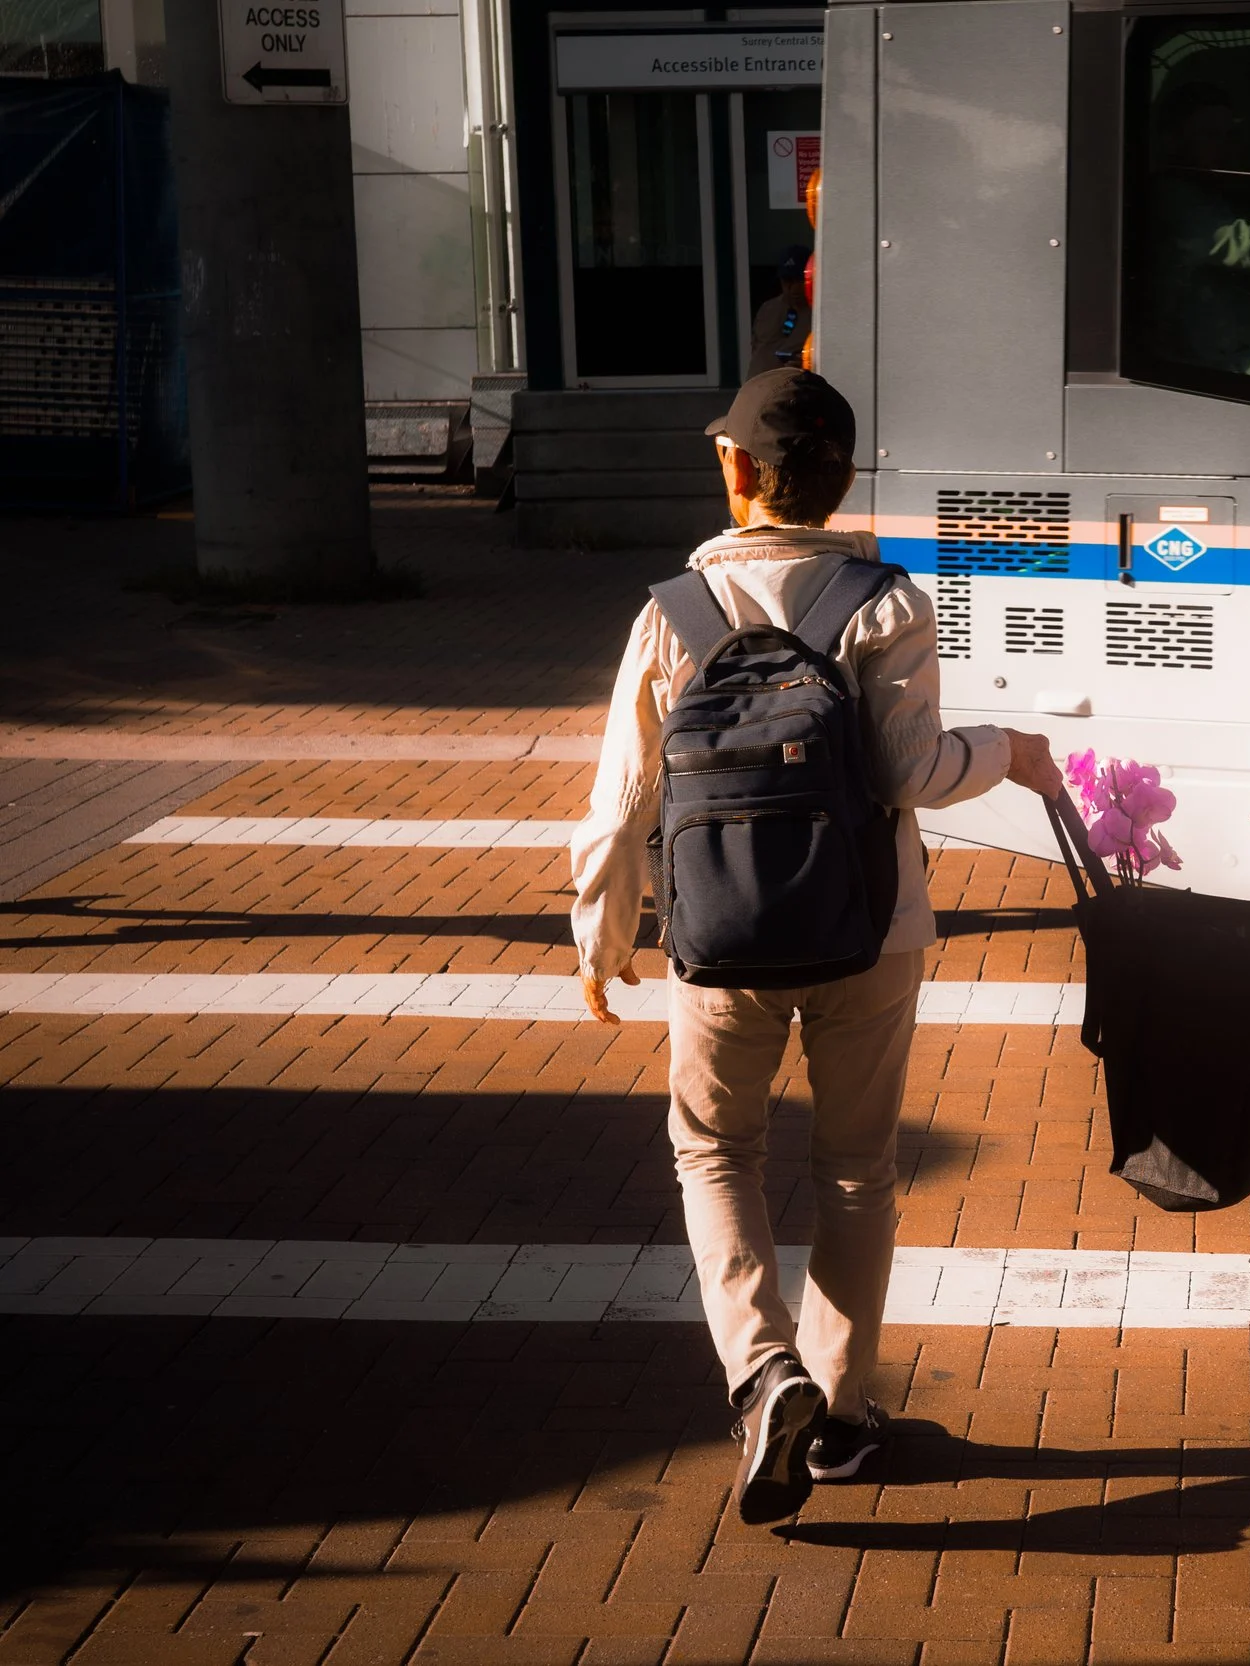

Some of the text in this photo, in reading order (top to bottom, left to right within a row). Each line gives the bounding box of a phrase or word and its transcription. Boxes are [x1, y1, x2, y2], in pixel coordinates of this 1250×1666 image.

[245, 8, 320, 28] ACCESS
[261, 33, 307, 52] ONLY
[741, 36, 772, 48] Surrey
[774, 35, 808, 46] Central
[651, 57, 739, 73] Accessible
[744, 56, 816, 72] Entrance
[1156, 539, 1195, 557] CNG
